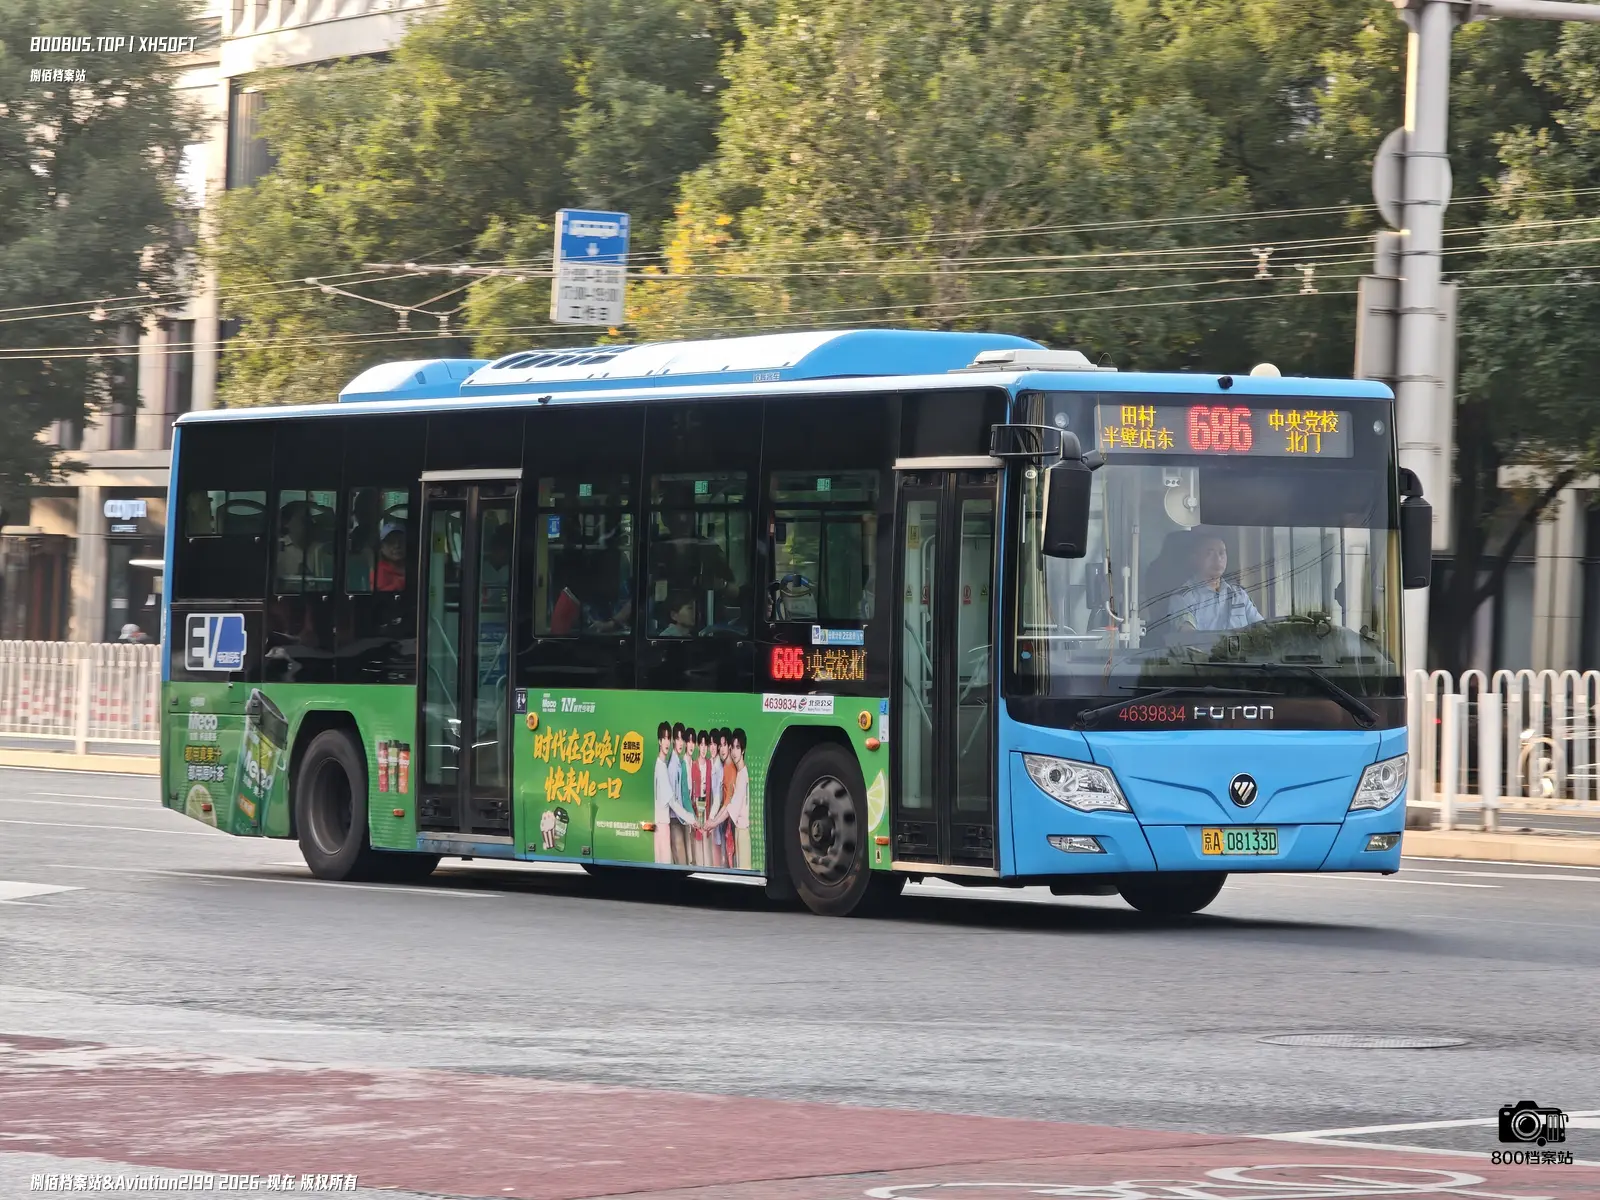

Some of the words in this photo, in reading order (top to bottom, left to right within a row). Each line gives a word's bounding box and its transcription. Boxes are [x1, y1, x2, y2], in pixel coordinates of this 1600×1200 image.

[1120, 406, 1156, 428] 田村
[1268, 409, 1340, 432] 中央党校
[1102, 427, 1174, 449] 半壁店东
[1188, 406, 1252, 451] 686
[1286, 431, 1321, 453] 北门
[772, 647, 804, 679] 686
[764, 697, 797, 709] 4639834
[1118, 705, 1186, 722] 4639834
[1193, 706, 1274, 720] FOTON
